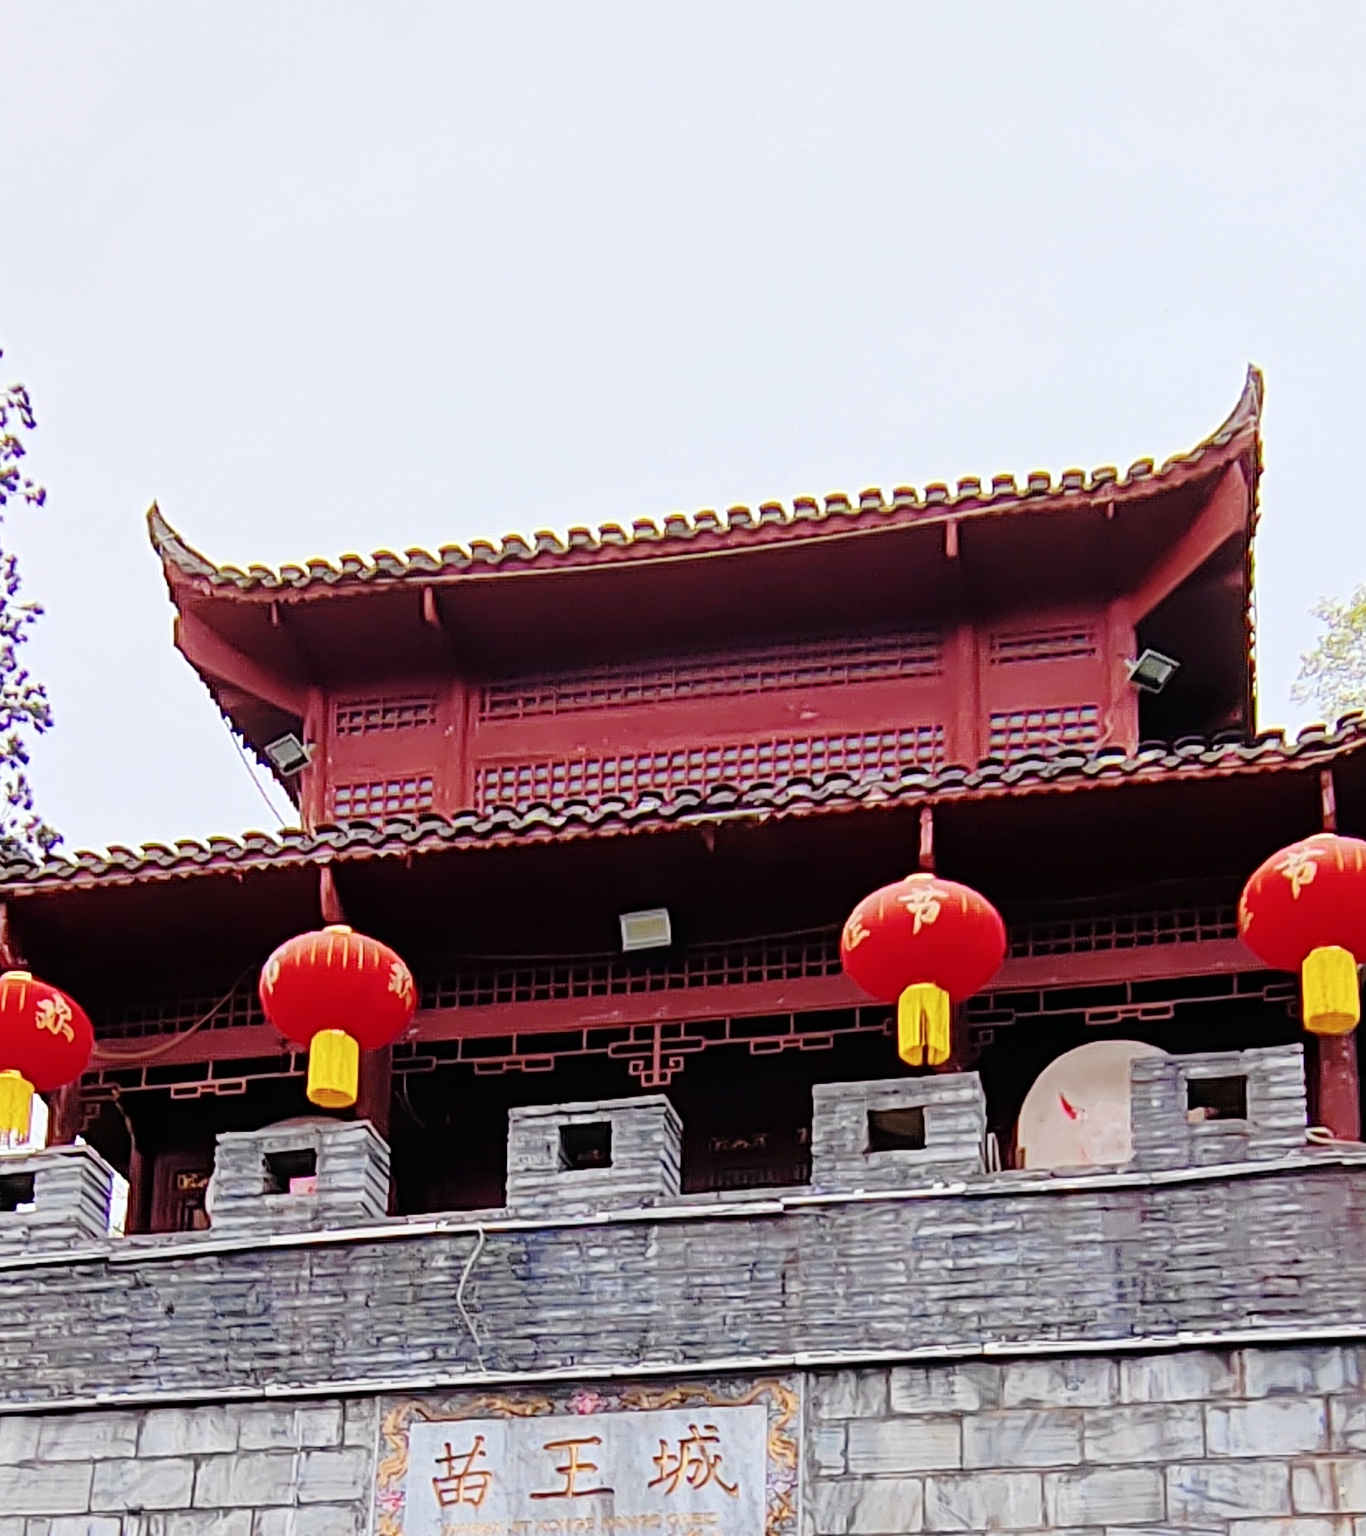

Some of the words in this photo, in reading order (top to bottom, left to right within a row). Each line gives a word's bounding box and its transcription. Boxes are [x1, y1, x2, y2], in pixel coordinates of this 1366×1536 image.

[1274, 846, 1327, 900] 节
[896, 885, 949, 935] 节
[431, 1423, 739, 1508] 苗王城
